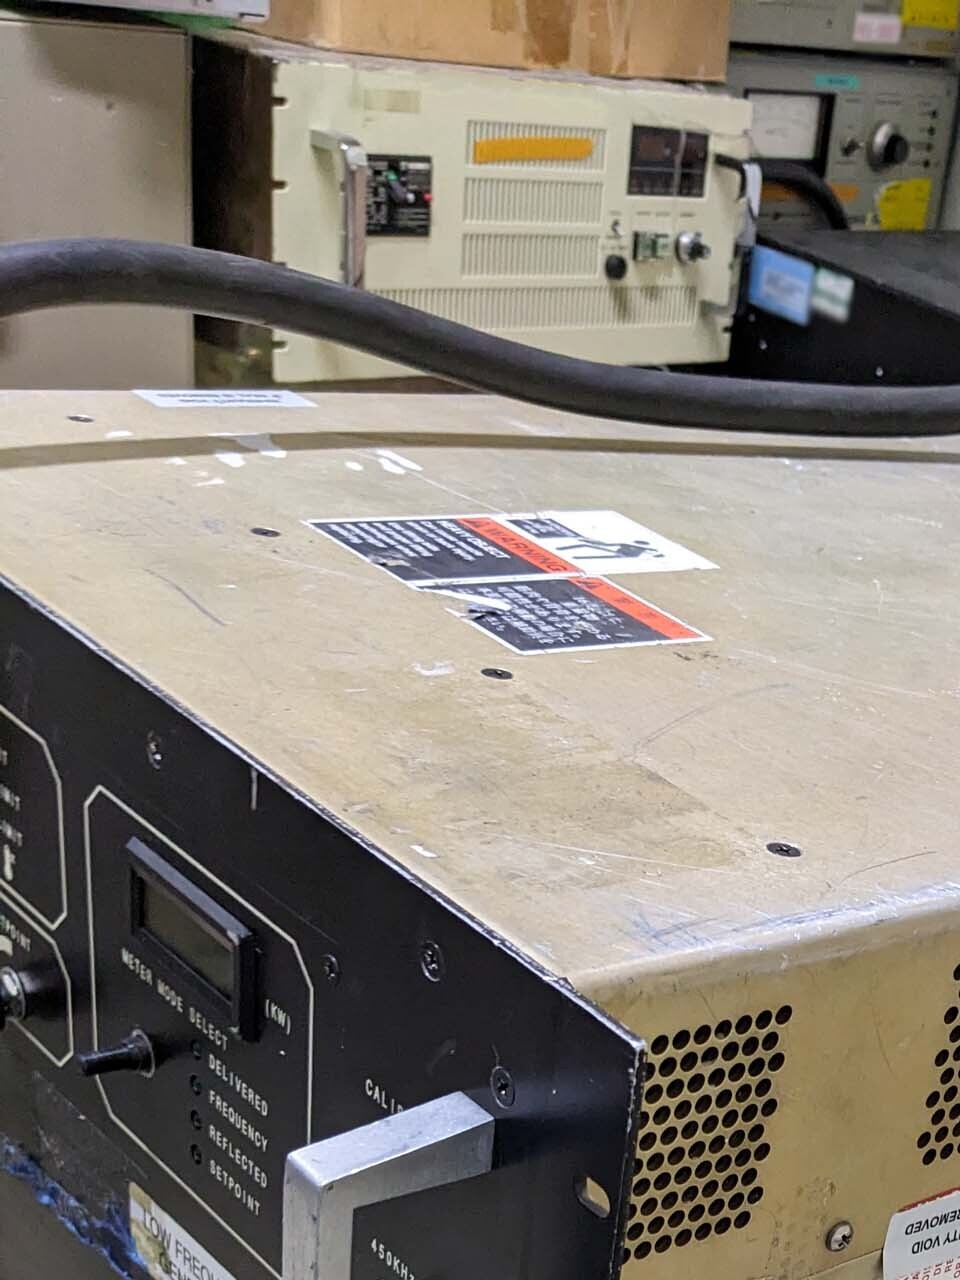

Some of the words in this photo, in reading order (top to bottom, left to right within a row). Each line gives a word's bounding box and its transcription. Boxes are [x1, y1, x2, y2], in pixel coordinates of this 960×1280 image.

[486, 525, 570, 574] WARNING
[121, 947, 153, 986] METER
[157, 979, 184, 1013] MODE
[189, 1007, 228, 1051] SELECT
[265, 999, 291, 1036] (KW)
[208, 1053, 269, 1117] DELIVERED
[209, 1089, 269, 1153] FREQUENCY
[208, 1124, 268, 1189] REFLECTED
[209, 1159, 261, 1216] SETPOINT
[141, 1207, 172, 1249] LOW
[911, 1237, 940, 1255] VOID
